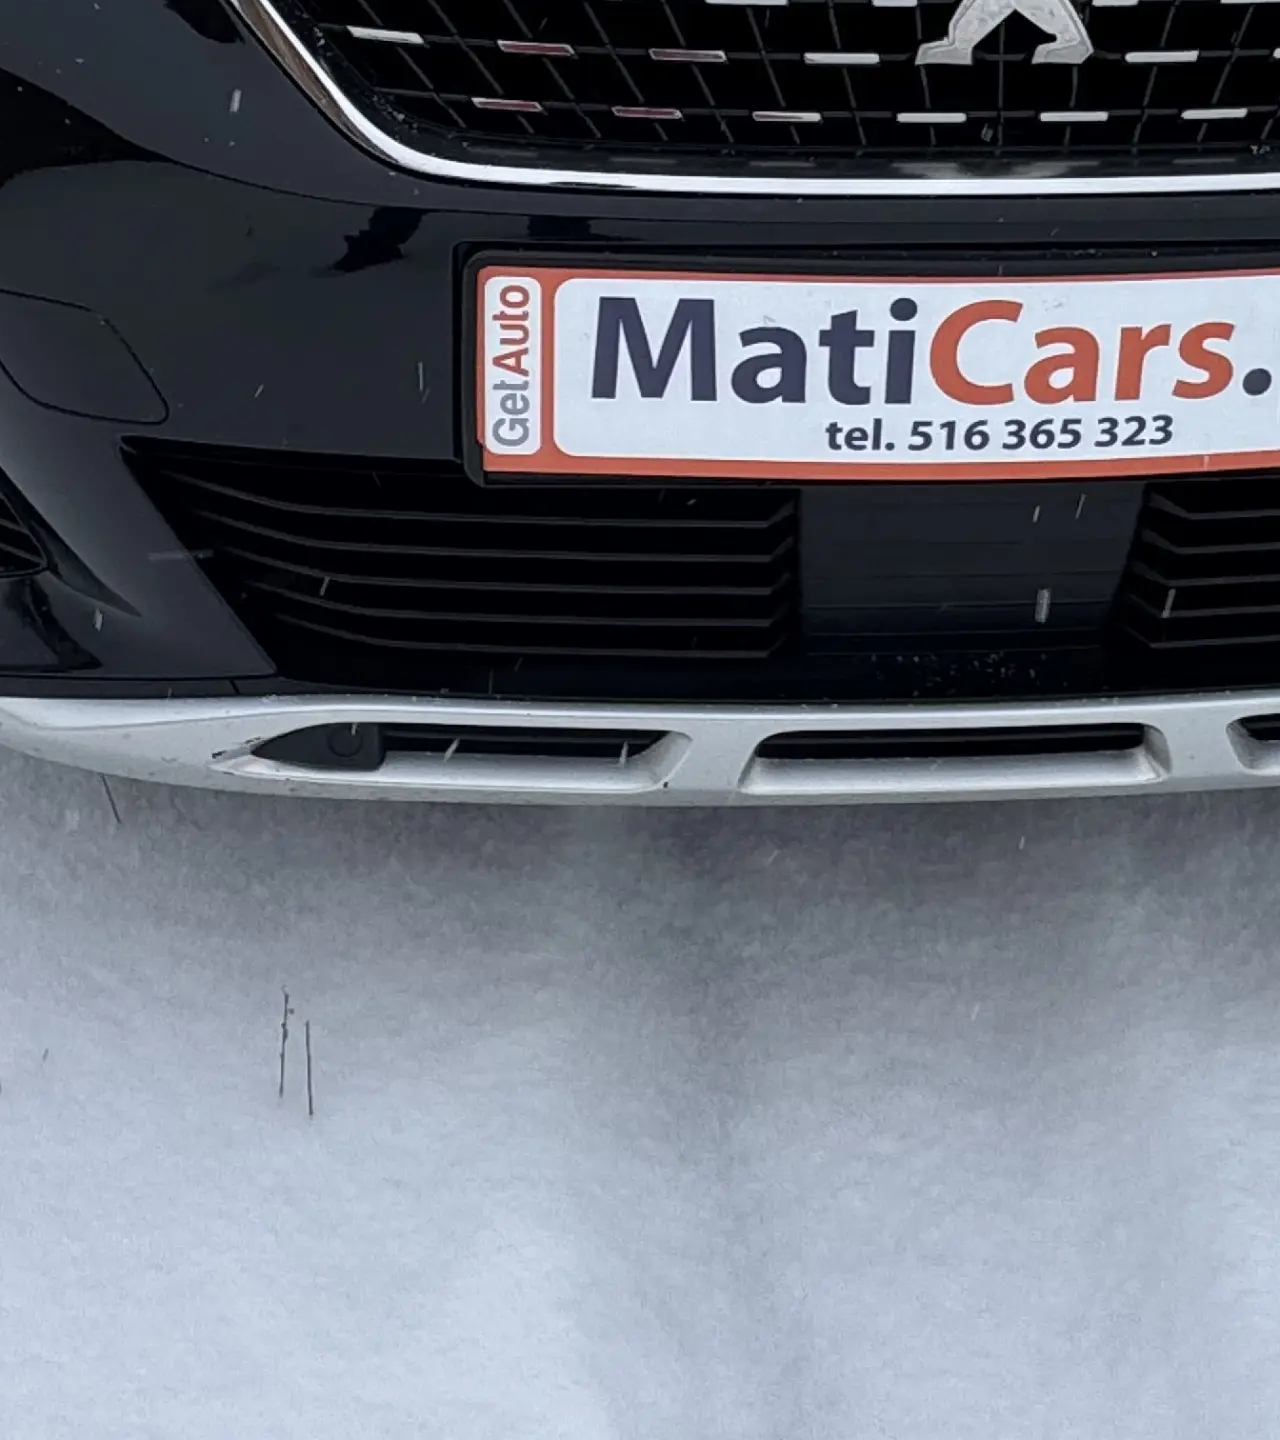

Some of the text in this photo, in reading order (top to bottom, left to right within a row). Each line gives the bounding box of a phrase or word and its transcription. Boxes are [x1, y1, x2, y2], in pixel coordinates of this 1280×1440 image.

[491, 284, 531, 448] GetAuto
[825, 414, 1174, 452] tel. 516 365 323
